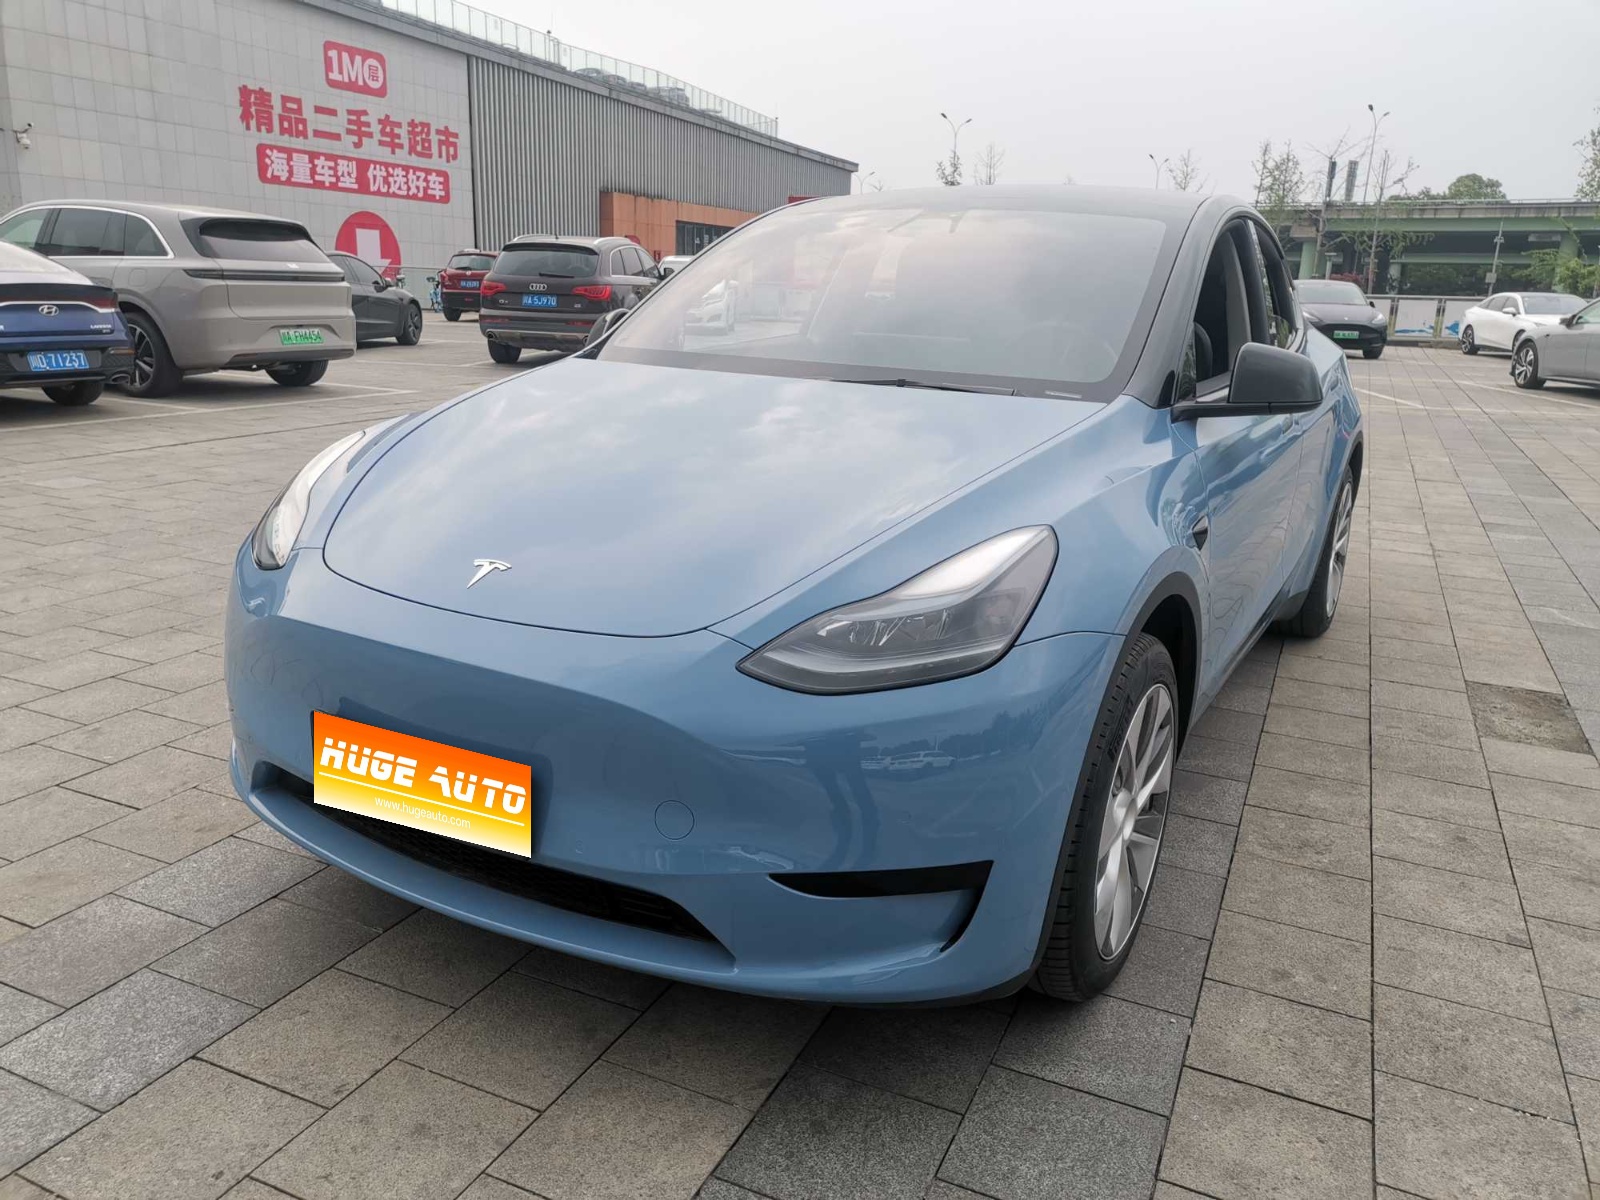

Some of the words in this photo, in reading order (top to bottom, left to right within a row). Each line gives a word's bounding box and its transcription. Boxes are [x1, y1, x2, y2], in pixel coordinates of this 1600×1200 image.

[238, 84, 459, 163] 精品二手车超市
[265, 148, 358, 189] 海量车型
[367, 164, 446, 200] 优选好车
